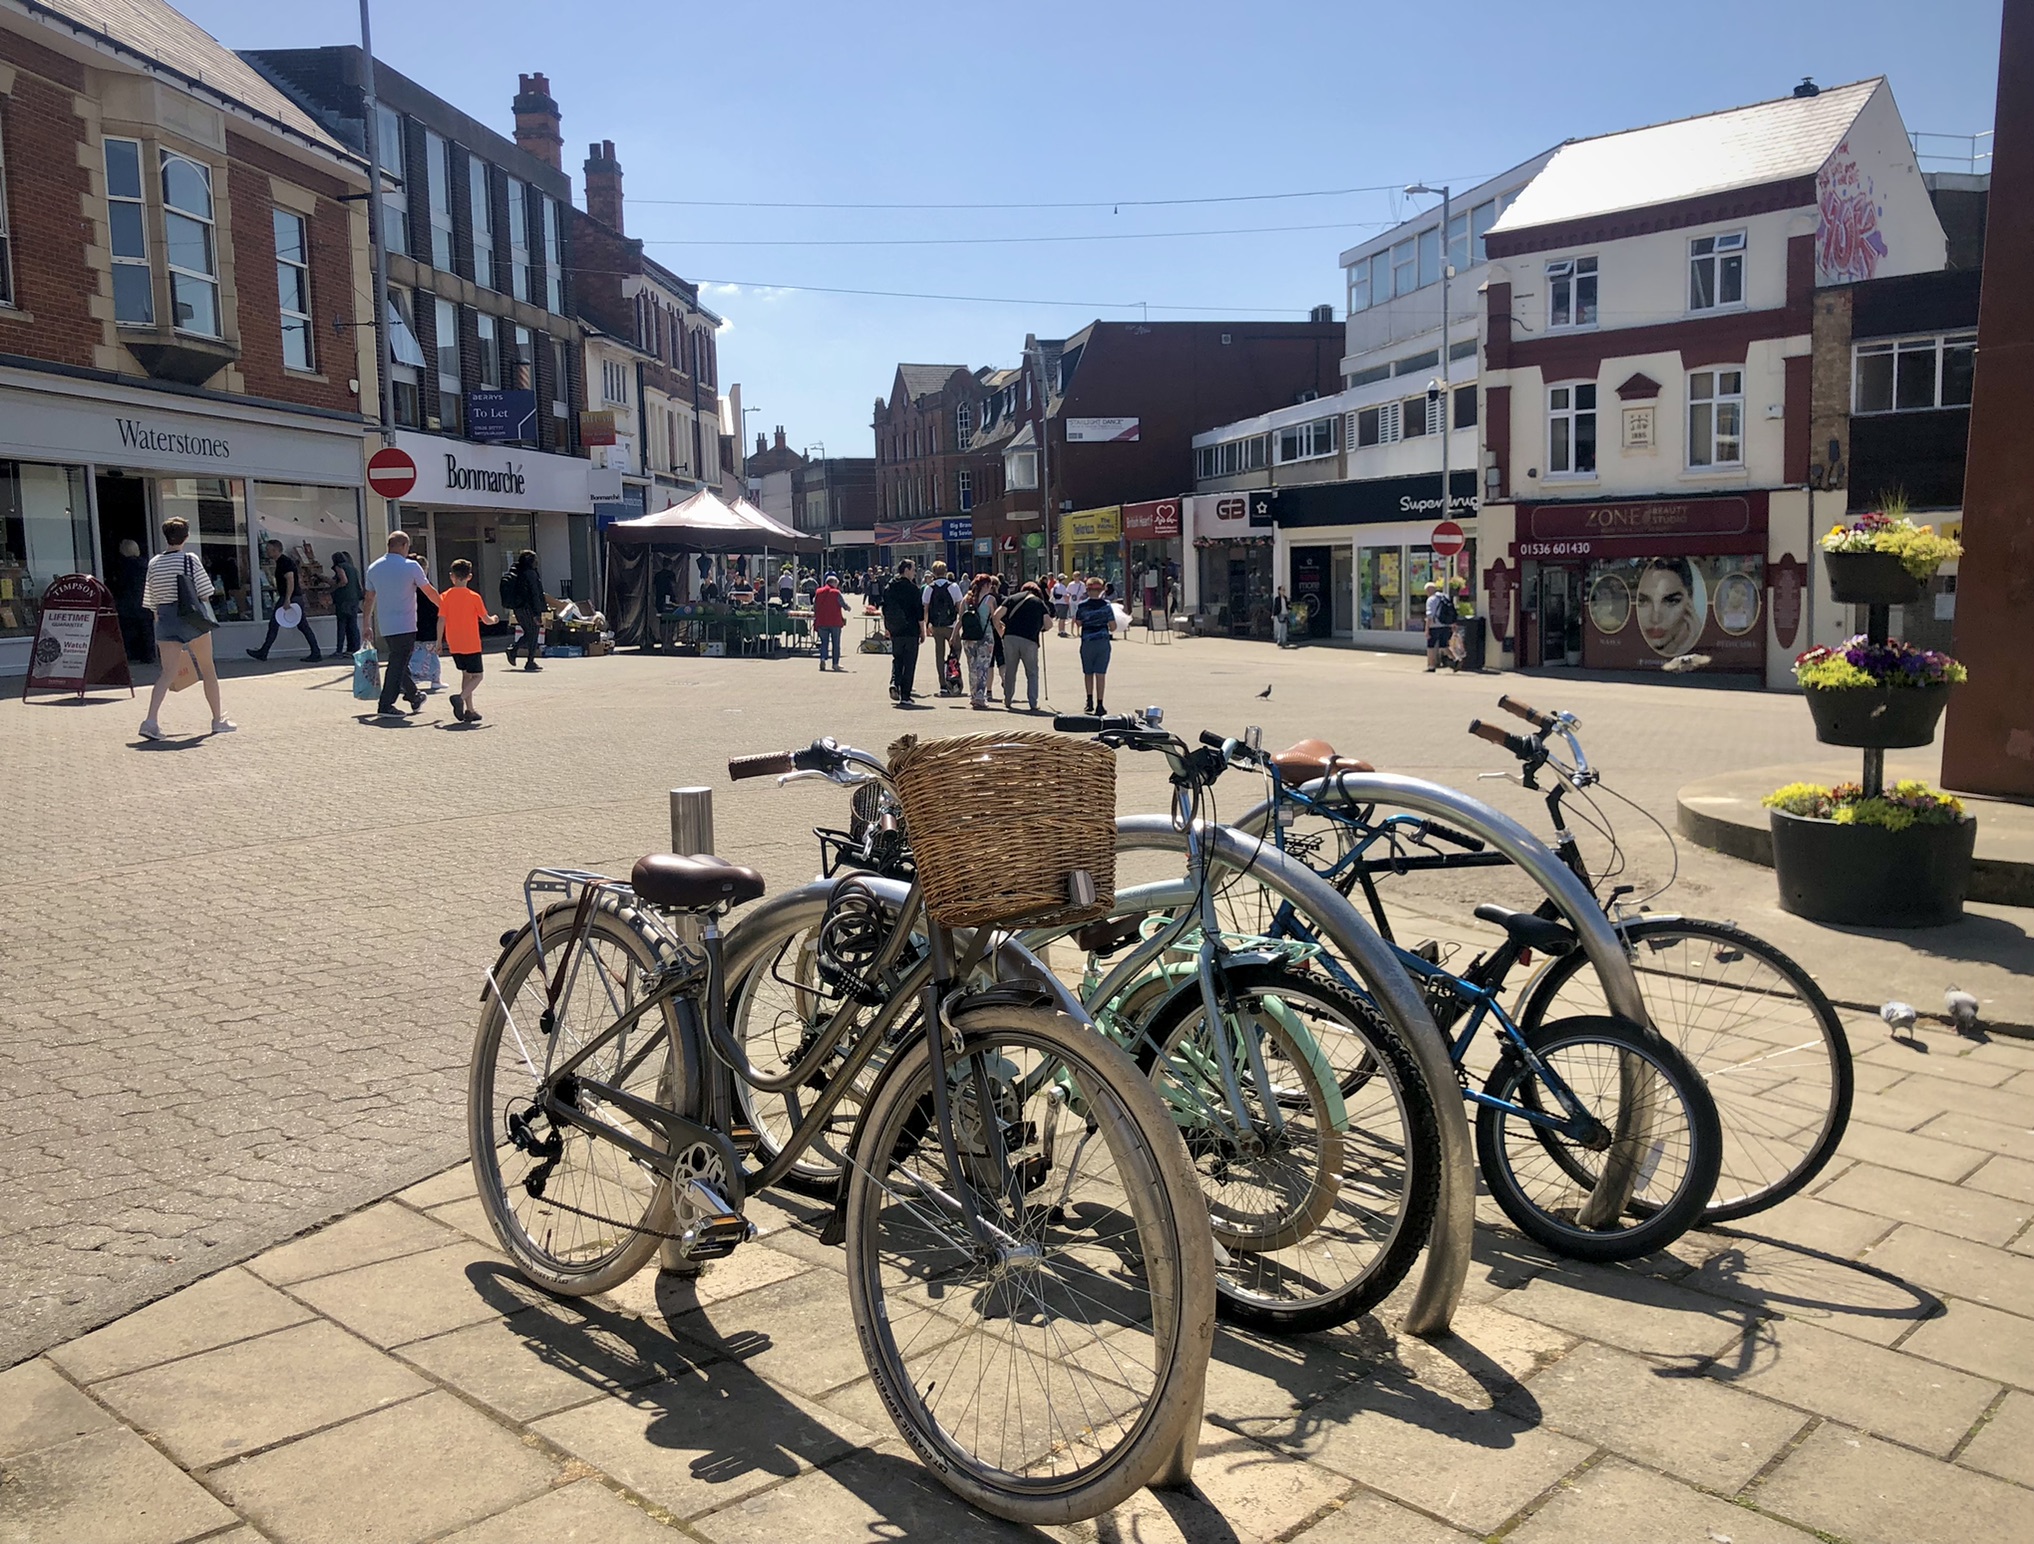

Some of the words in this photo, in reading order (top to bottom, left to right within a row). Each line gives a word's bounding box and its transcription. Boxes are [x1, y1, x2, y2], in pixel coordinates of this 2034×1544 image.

[473, 408, 488, 418] To
[491, 408, 509, 418] Let
[115, 418, 230, 459] Waterstones
[443, 453, 526, 496] Bonmarché
[590, 493, 620, 501] Bonmarché
[1652, 506, 1687, 515] BEAUTY
[1585, 507, 1641, 528] ZONE
[1652, 515, 1687, 524] STUDIO
[949, 522, 959, 530] Big
[1520, 543, 1550, 555] 01536
[1553, 542, 1591, 554] 601430
[53, 582, 96, 598] TIMPSON
[48, 612, 91, 622] LIFETIME
[63, 641, 88, 649] Watch
[872, 1367, 903, 1421] ZEPPELIN
[901, 1420, 934, 1461] CLASSIC
[933, 1459, 949, 1474] CST
